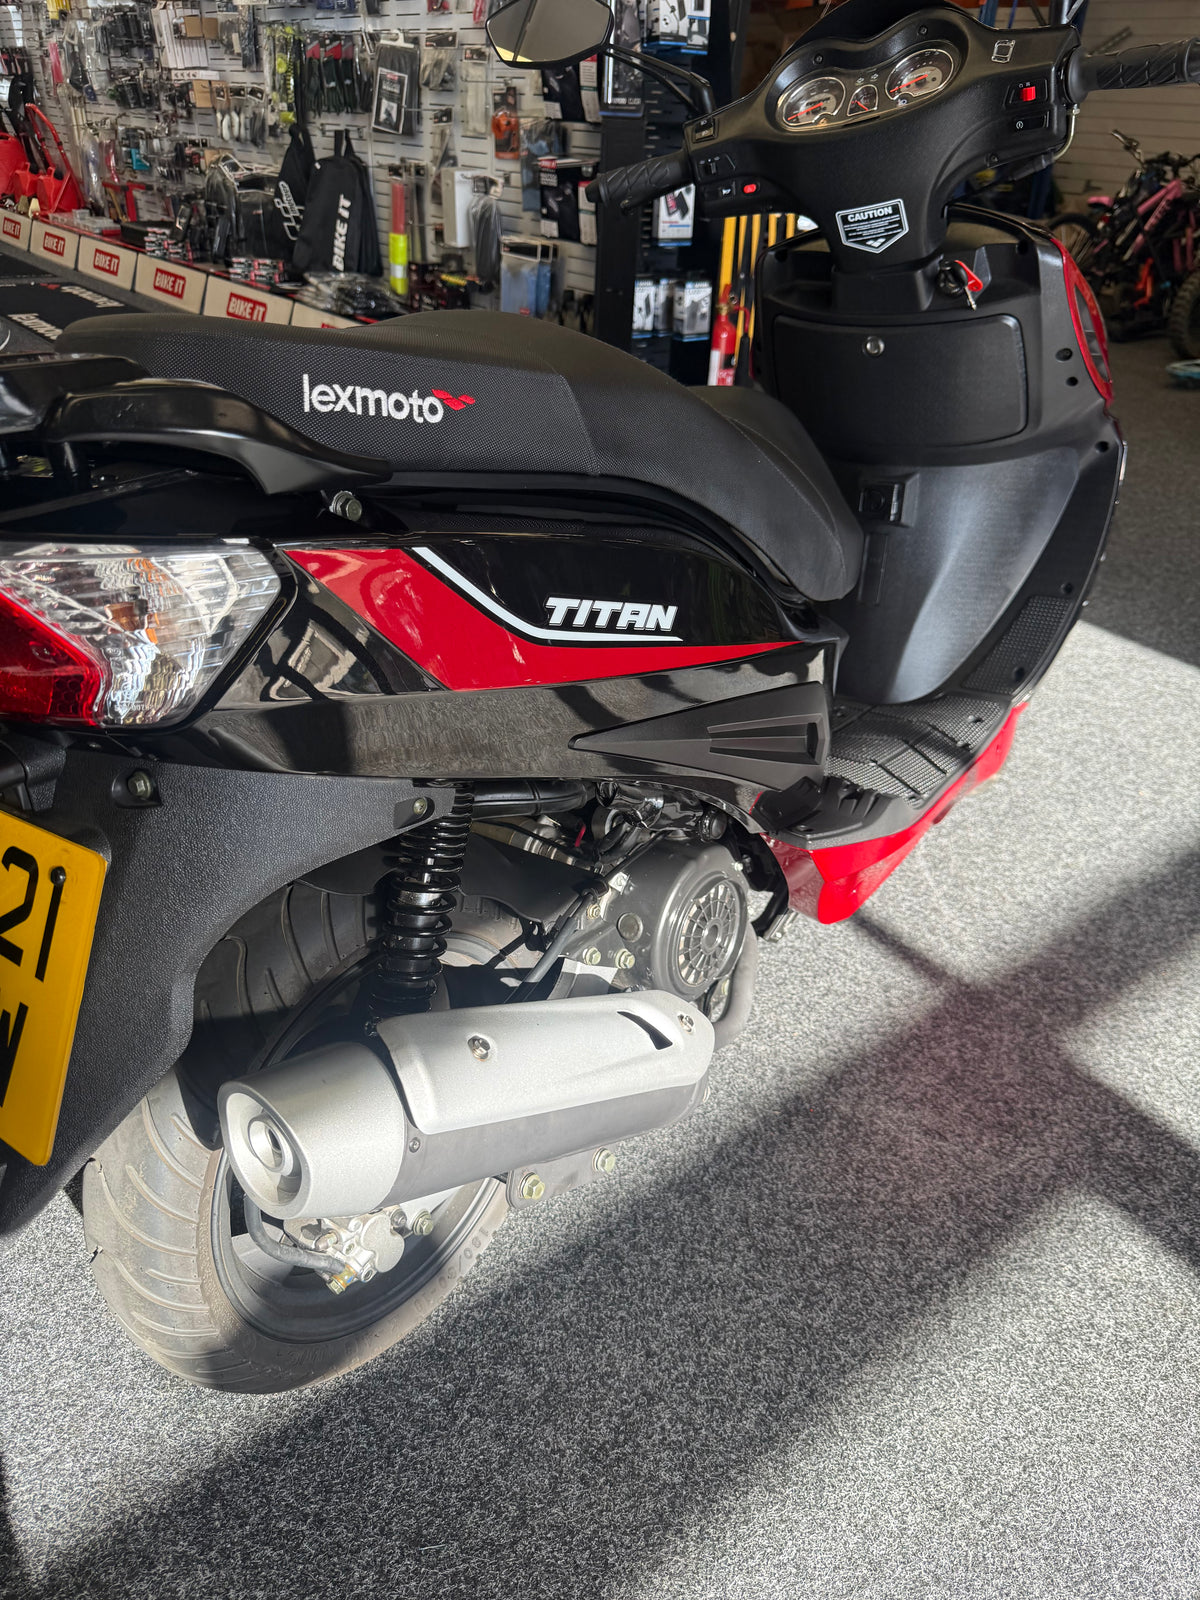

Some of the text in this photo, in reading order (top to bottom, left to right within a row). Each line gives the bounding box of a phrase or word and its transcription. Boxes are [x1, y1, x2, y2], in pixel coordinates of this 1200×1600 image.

[847, 206, 893, 222] CAUTION
[4, 220, 20, 238] BIKE IT
[332, 193, 351, 272] BIKE IT
[44, 236, 64, 254] BIKE IT
[94, 252, 118, 272] BIKE IT
[156, 273, 184, 294] BIKE IT
[228, 297, 266, 322] BIKE IT
[302, 373, 444, 424] lexmoto
[545, 597, 679, 631] TITAN
